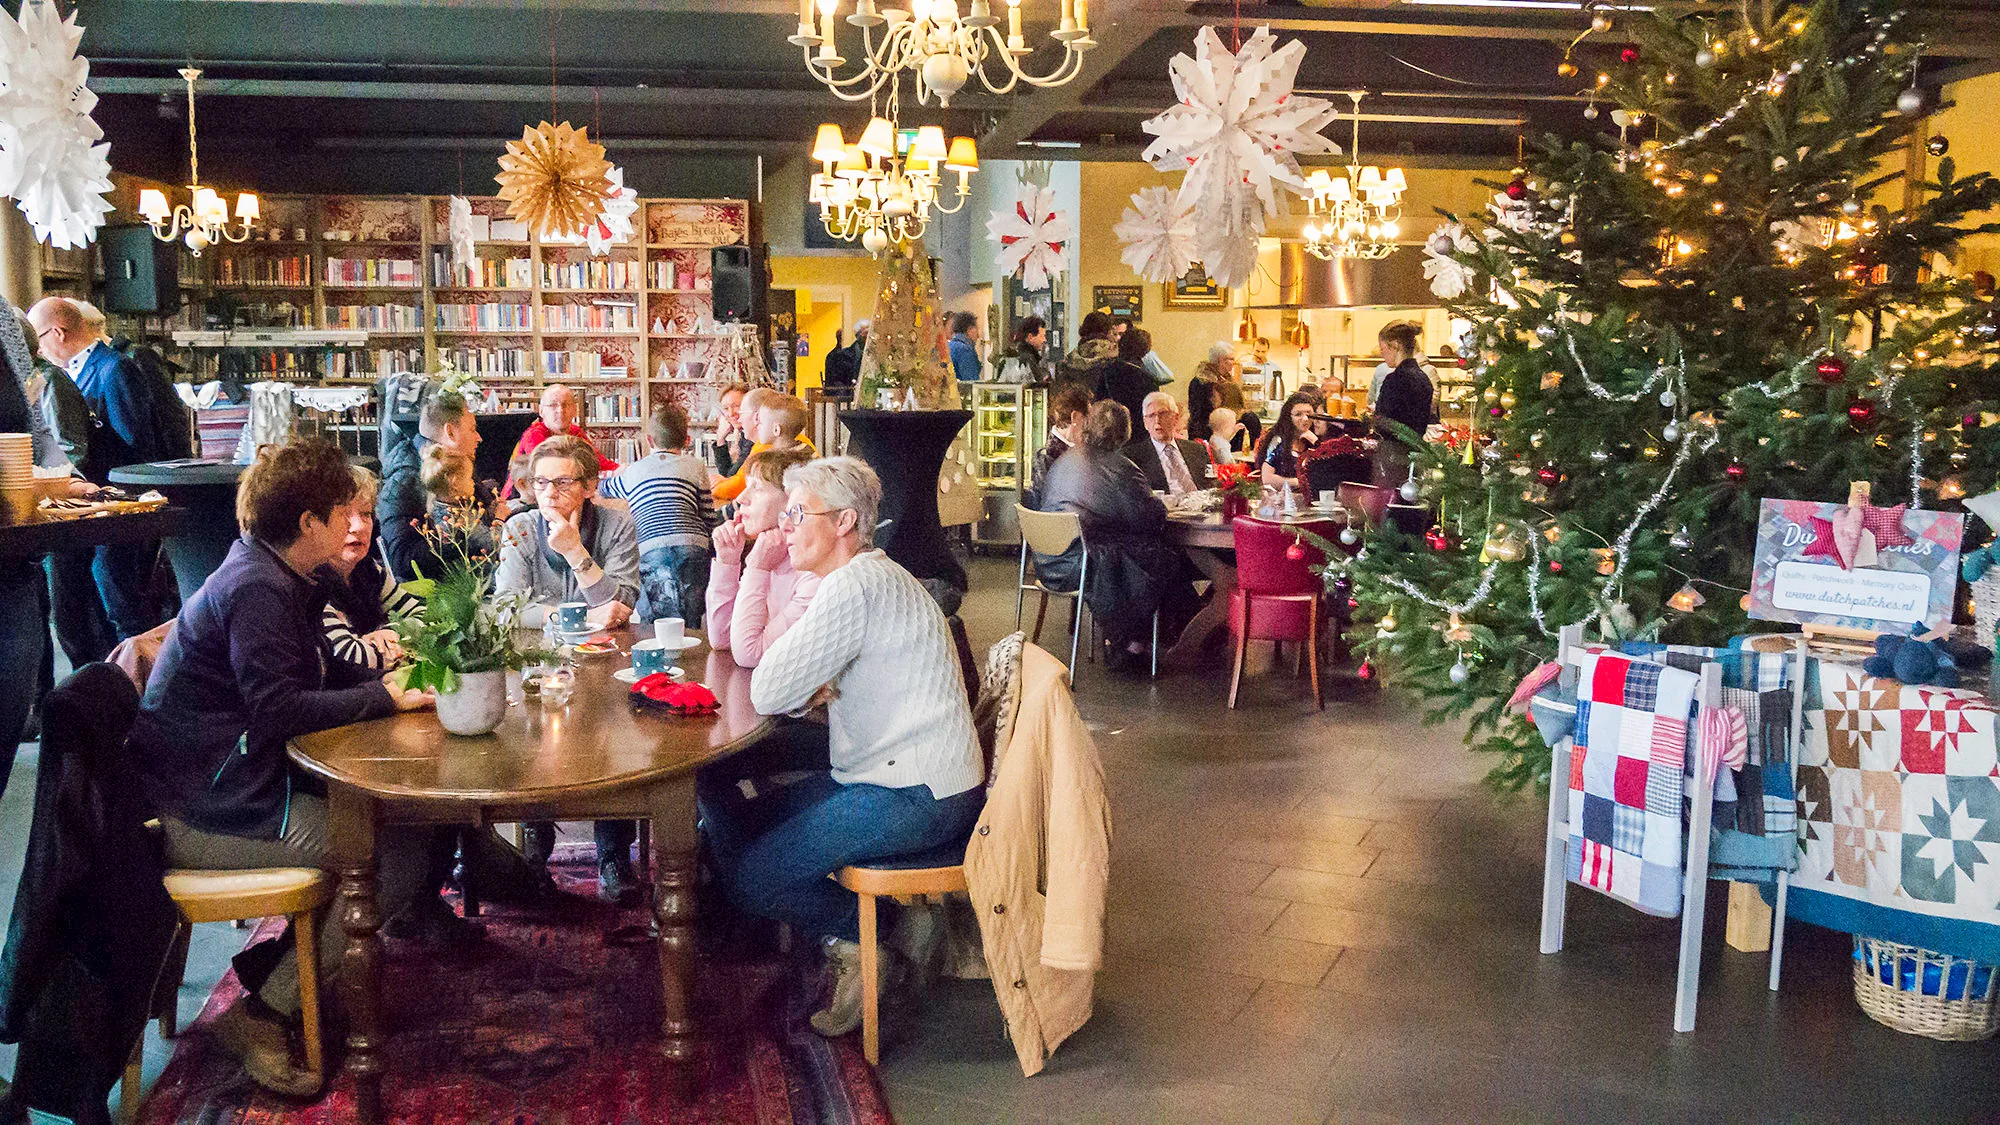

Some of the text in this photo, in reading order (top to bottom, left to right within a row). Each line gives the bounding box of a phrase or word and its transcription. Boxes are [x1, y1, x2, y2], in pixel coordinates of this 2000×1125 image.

[1812, 573, 1856, 585] Patchwork
[1861, 578, 1896, 591] Memory
[1897, 582, 1923, 593] Quilts
[1785, 590, 1916, 611] www.dutchpatches.nl
